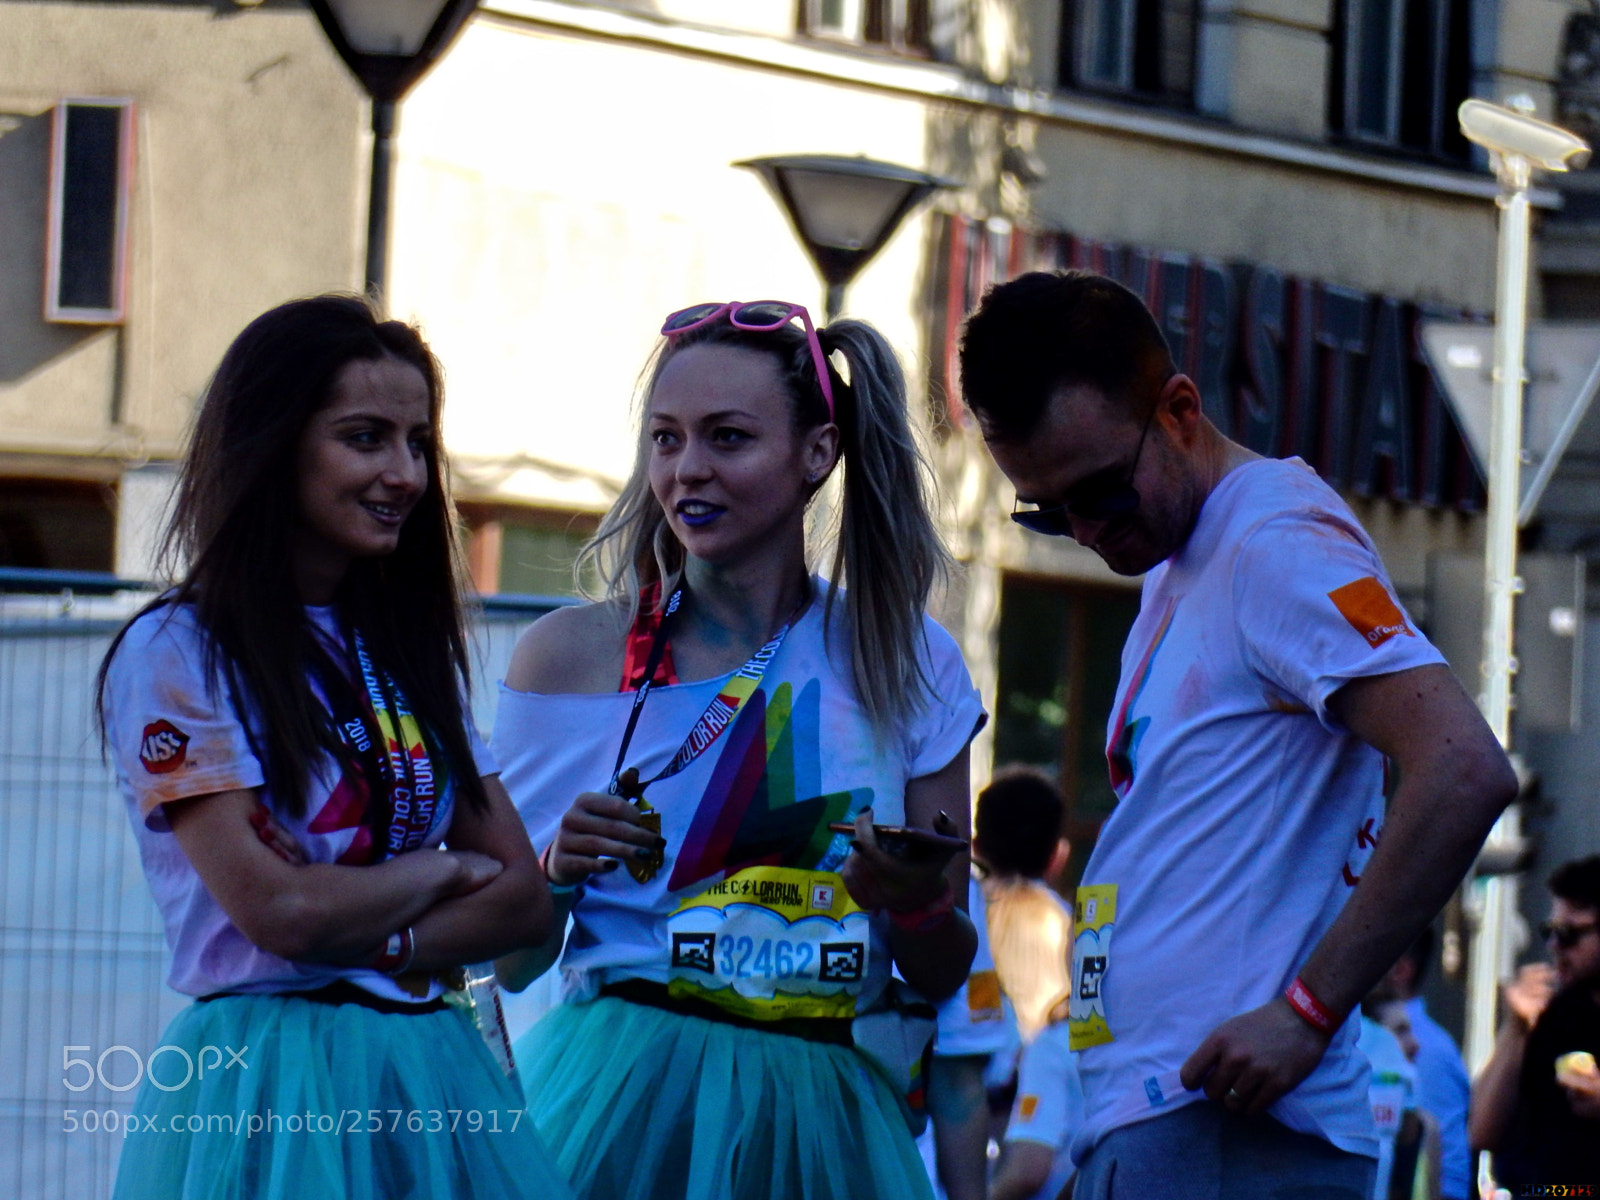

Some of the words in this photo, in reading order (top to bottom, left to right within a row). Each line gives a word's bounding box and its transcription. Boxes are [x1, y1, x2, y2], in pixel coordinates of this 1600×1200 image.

[344, 717, 372, 753] 2018
[677, 721, 715, 770] COLOR
[705, 696, 735, 735] RUN
[411, 757, 433, 797] RUN
[387, 787, 412, 852] COLOR
[708, 881, 728, 895] THE
[719, 934, 815, 980] 32462
